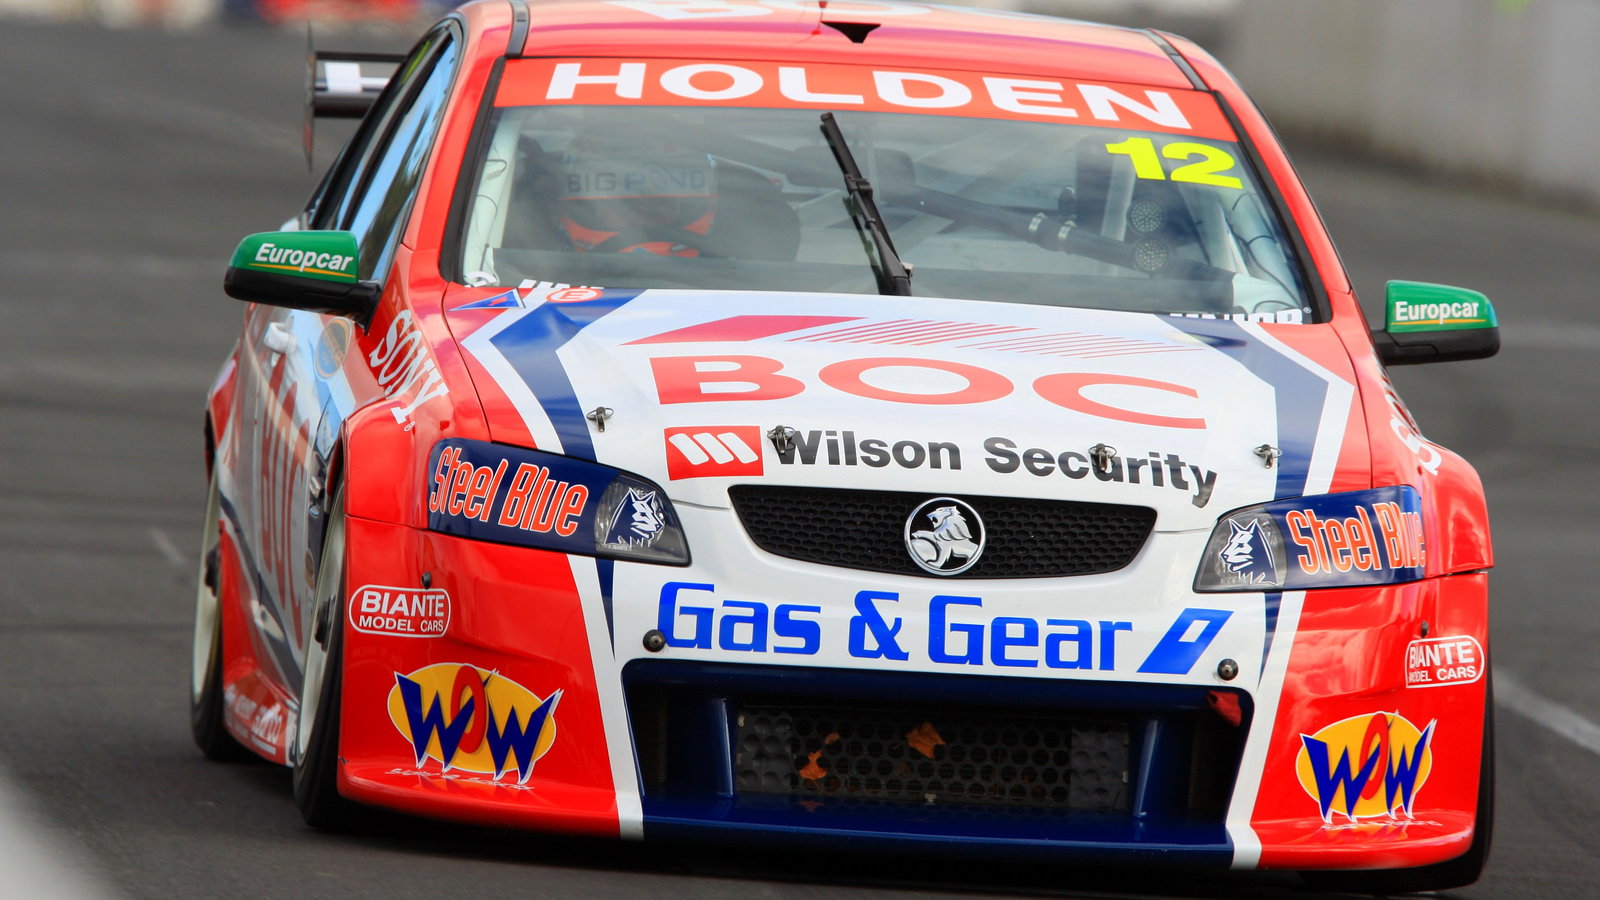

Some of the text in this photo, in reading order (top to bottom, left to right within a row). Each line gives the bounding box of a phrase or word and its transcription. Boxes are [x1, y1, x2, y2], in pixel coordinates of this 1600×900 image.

[546, 62, 1191, 130] HOLDEN
[1105, 137, 1243, 189] 12
[255, 242, 354, 272] Europcar
[1394, 300, 1480, 324] Europcar
[369, 309, 450, 425] SONY
[649, 355, 1206, 430] BOC
[428, 446, 589, 537] Steel Blue
[769, 430, 1218, 509] Wilson Security
[1286, 501, 1426, 575] Steel Blue
[358, 616, 444, 633] MODEL CARS
[360, 590, 445, 617] BIANTE
[658, 581, 1132, 670] Gas & Gear
[1409, 641, 1475, 669] BIANTE
[1436, 665, 1477, 681] CARS
[393, 663, 564, 784] WOW
[1300, 709, 1438, 825] WOW
